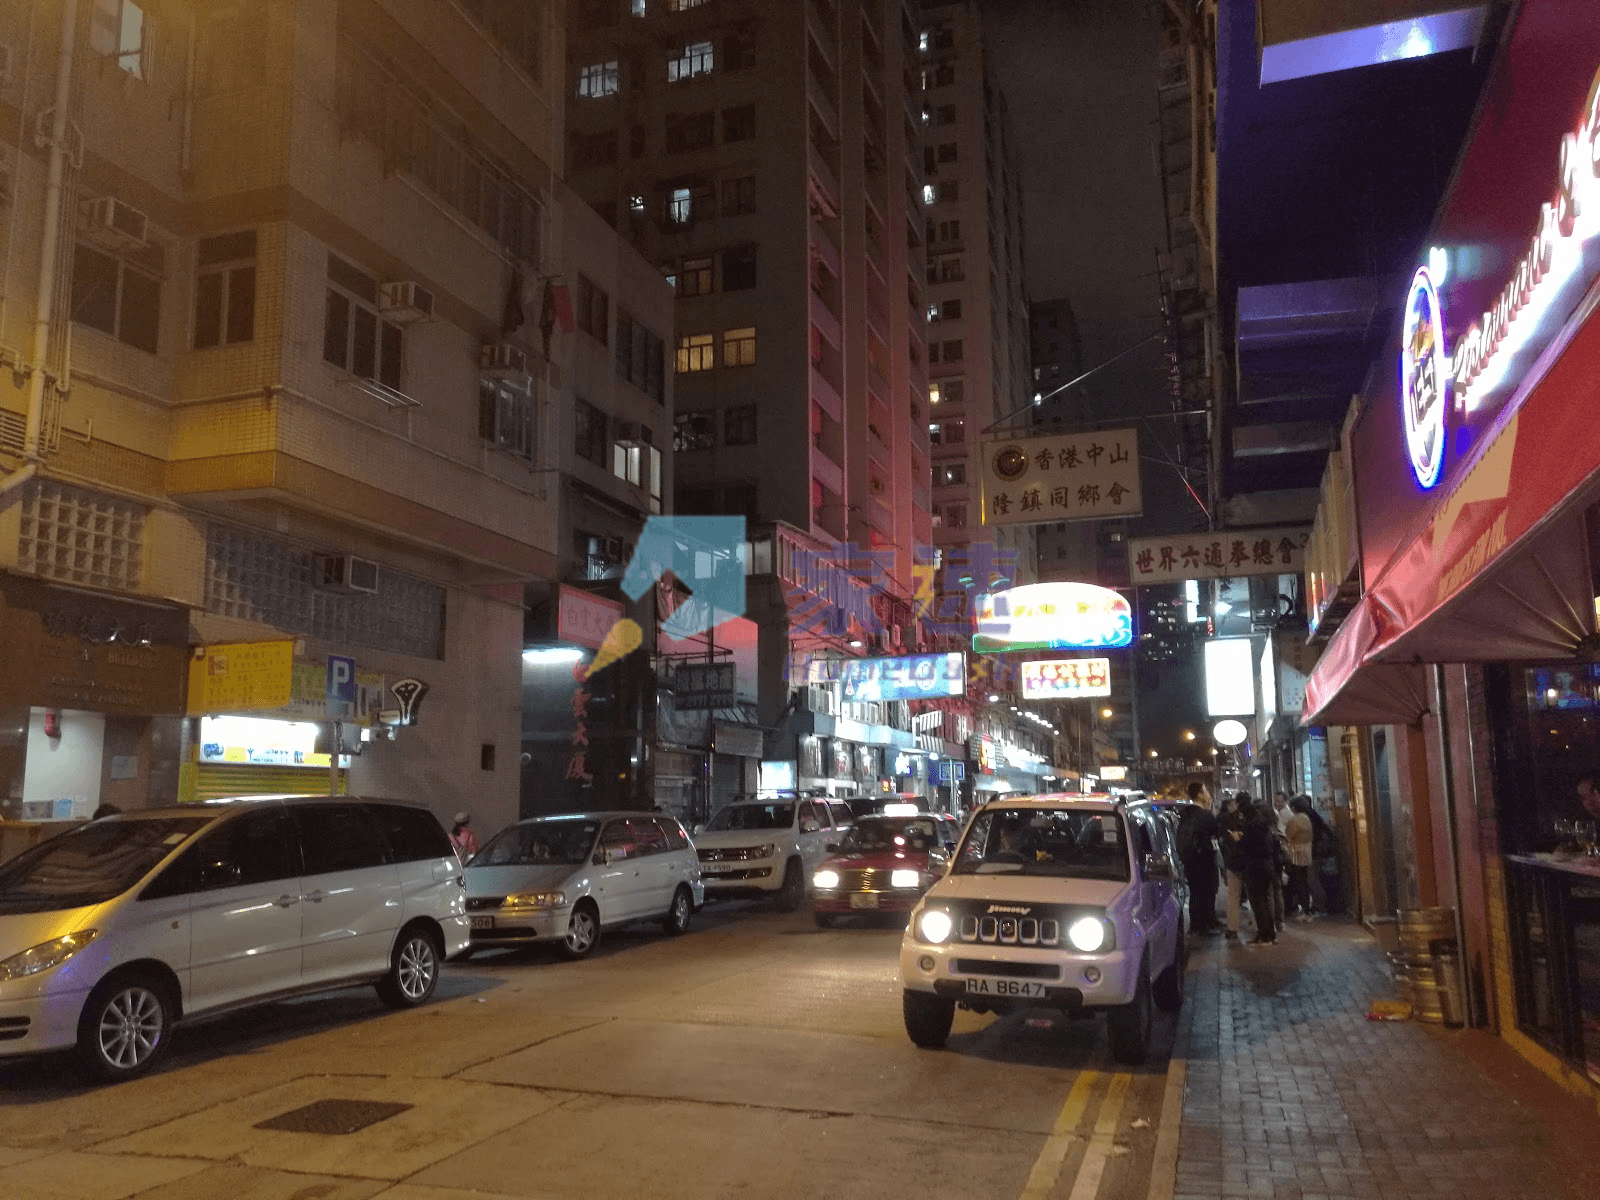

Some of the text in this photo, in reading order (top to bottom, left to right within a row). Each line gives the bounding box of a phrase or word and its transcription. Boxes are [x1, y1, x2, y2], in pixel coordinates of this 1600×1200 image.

[1034, 442, 1129, 471] 香港中山
[992, 481, 1131, 516] 隆鎮同鄉會
[1135, 536, 1298, 575] 世界六通拳總會
[331, 659, 350, 697] P
[967, 978, 1043, 996] RA 8647
